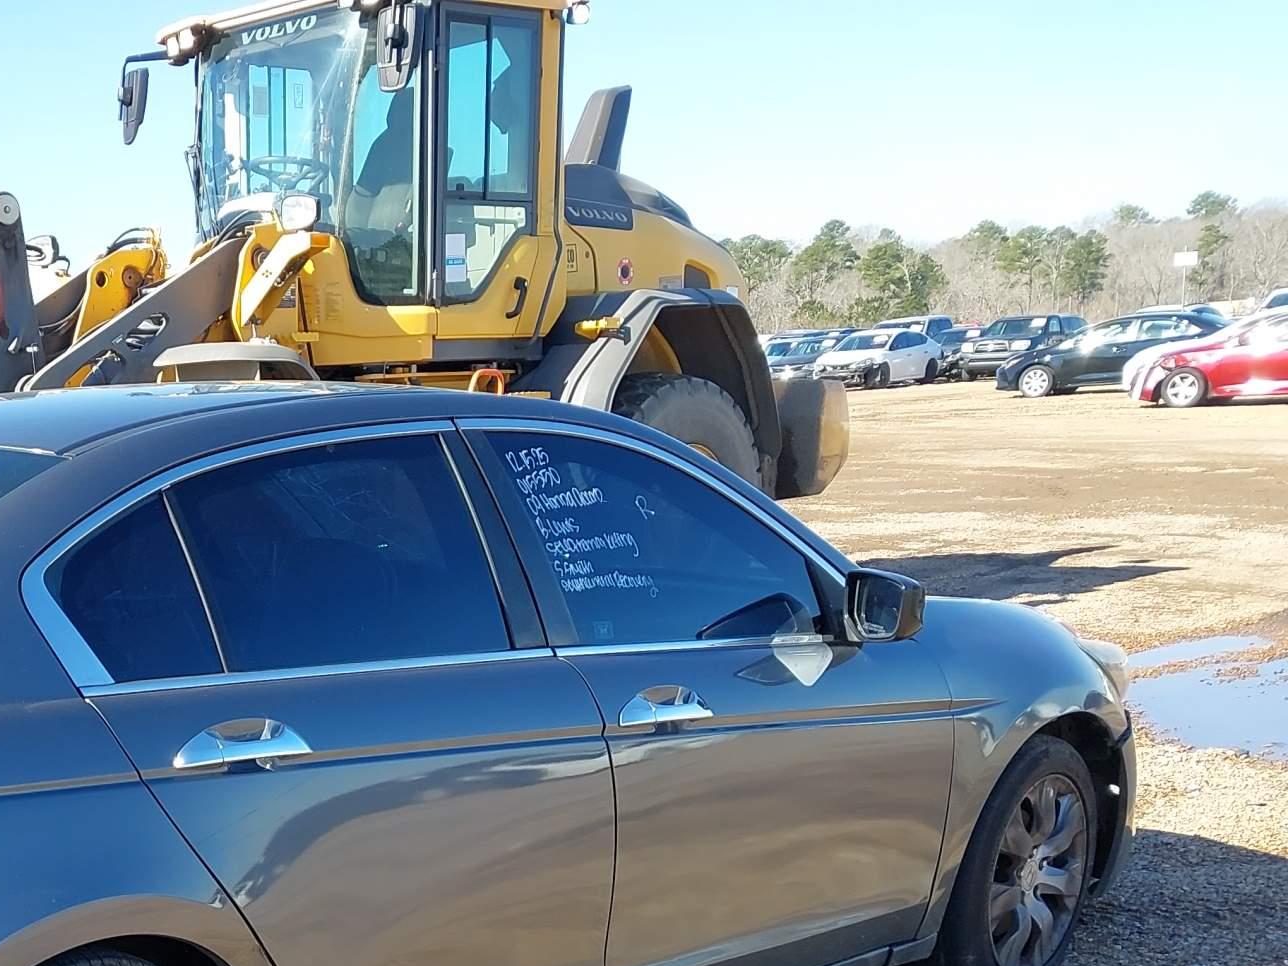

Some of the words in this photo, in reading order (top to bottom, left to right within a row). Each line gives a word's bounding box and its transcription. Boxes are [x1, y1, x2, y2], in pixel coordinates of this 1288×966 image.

[241, 15, 317, 45] VOLVO
[567, 206, 628, 222] VOLVO
[635, 495, 655, 520] R
